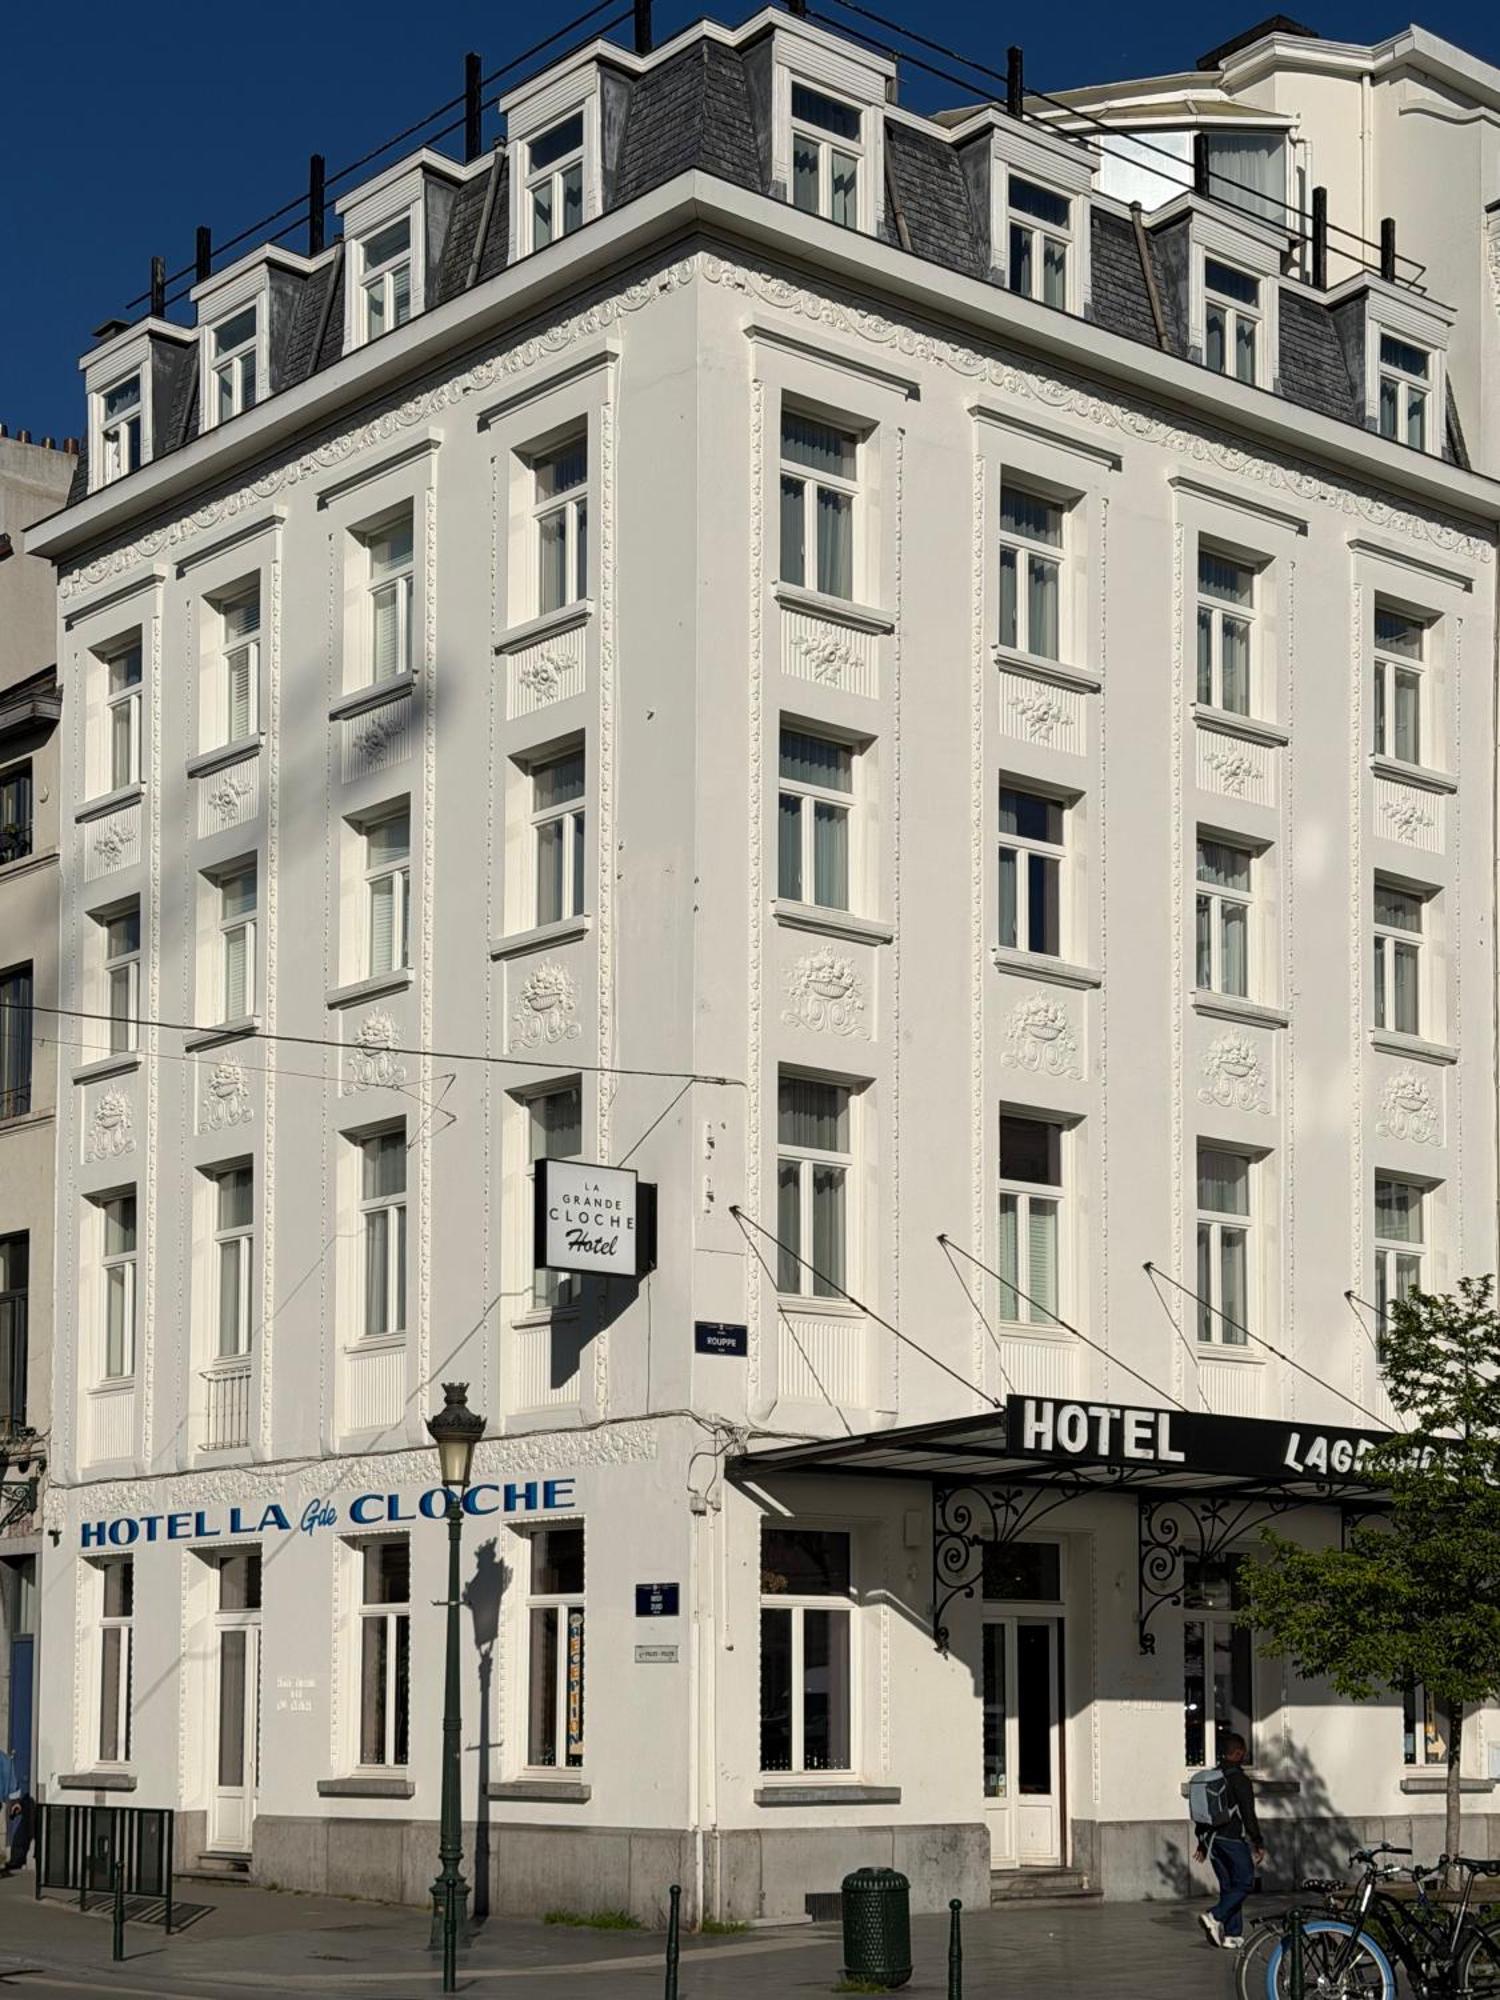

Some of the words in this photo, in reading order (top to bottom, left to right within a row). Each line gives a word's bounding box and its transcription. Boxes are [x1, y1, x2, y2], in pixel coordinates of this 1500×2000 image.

[584, 1182, 600, 1192] LA
[562, 1194, 622, 1210] GRANDE
[549, 1207, 635, 1230] CLOCHE
[565, 1228, 618, 1256] Hotel
[1023, 1399, 1186, 1462] HOTEL
[80, 1510, 221, 1548] HOTEL
[229, 1503, 292, 1534] LA
[299, 1498, 338, 1536] Gde
[349, 1478, 576, 1525] CLOCHE
[568, 1626, 581, 1745] RECEPTION
